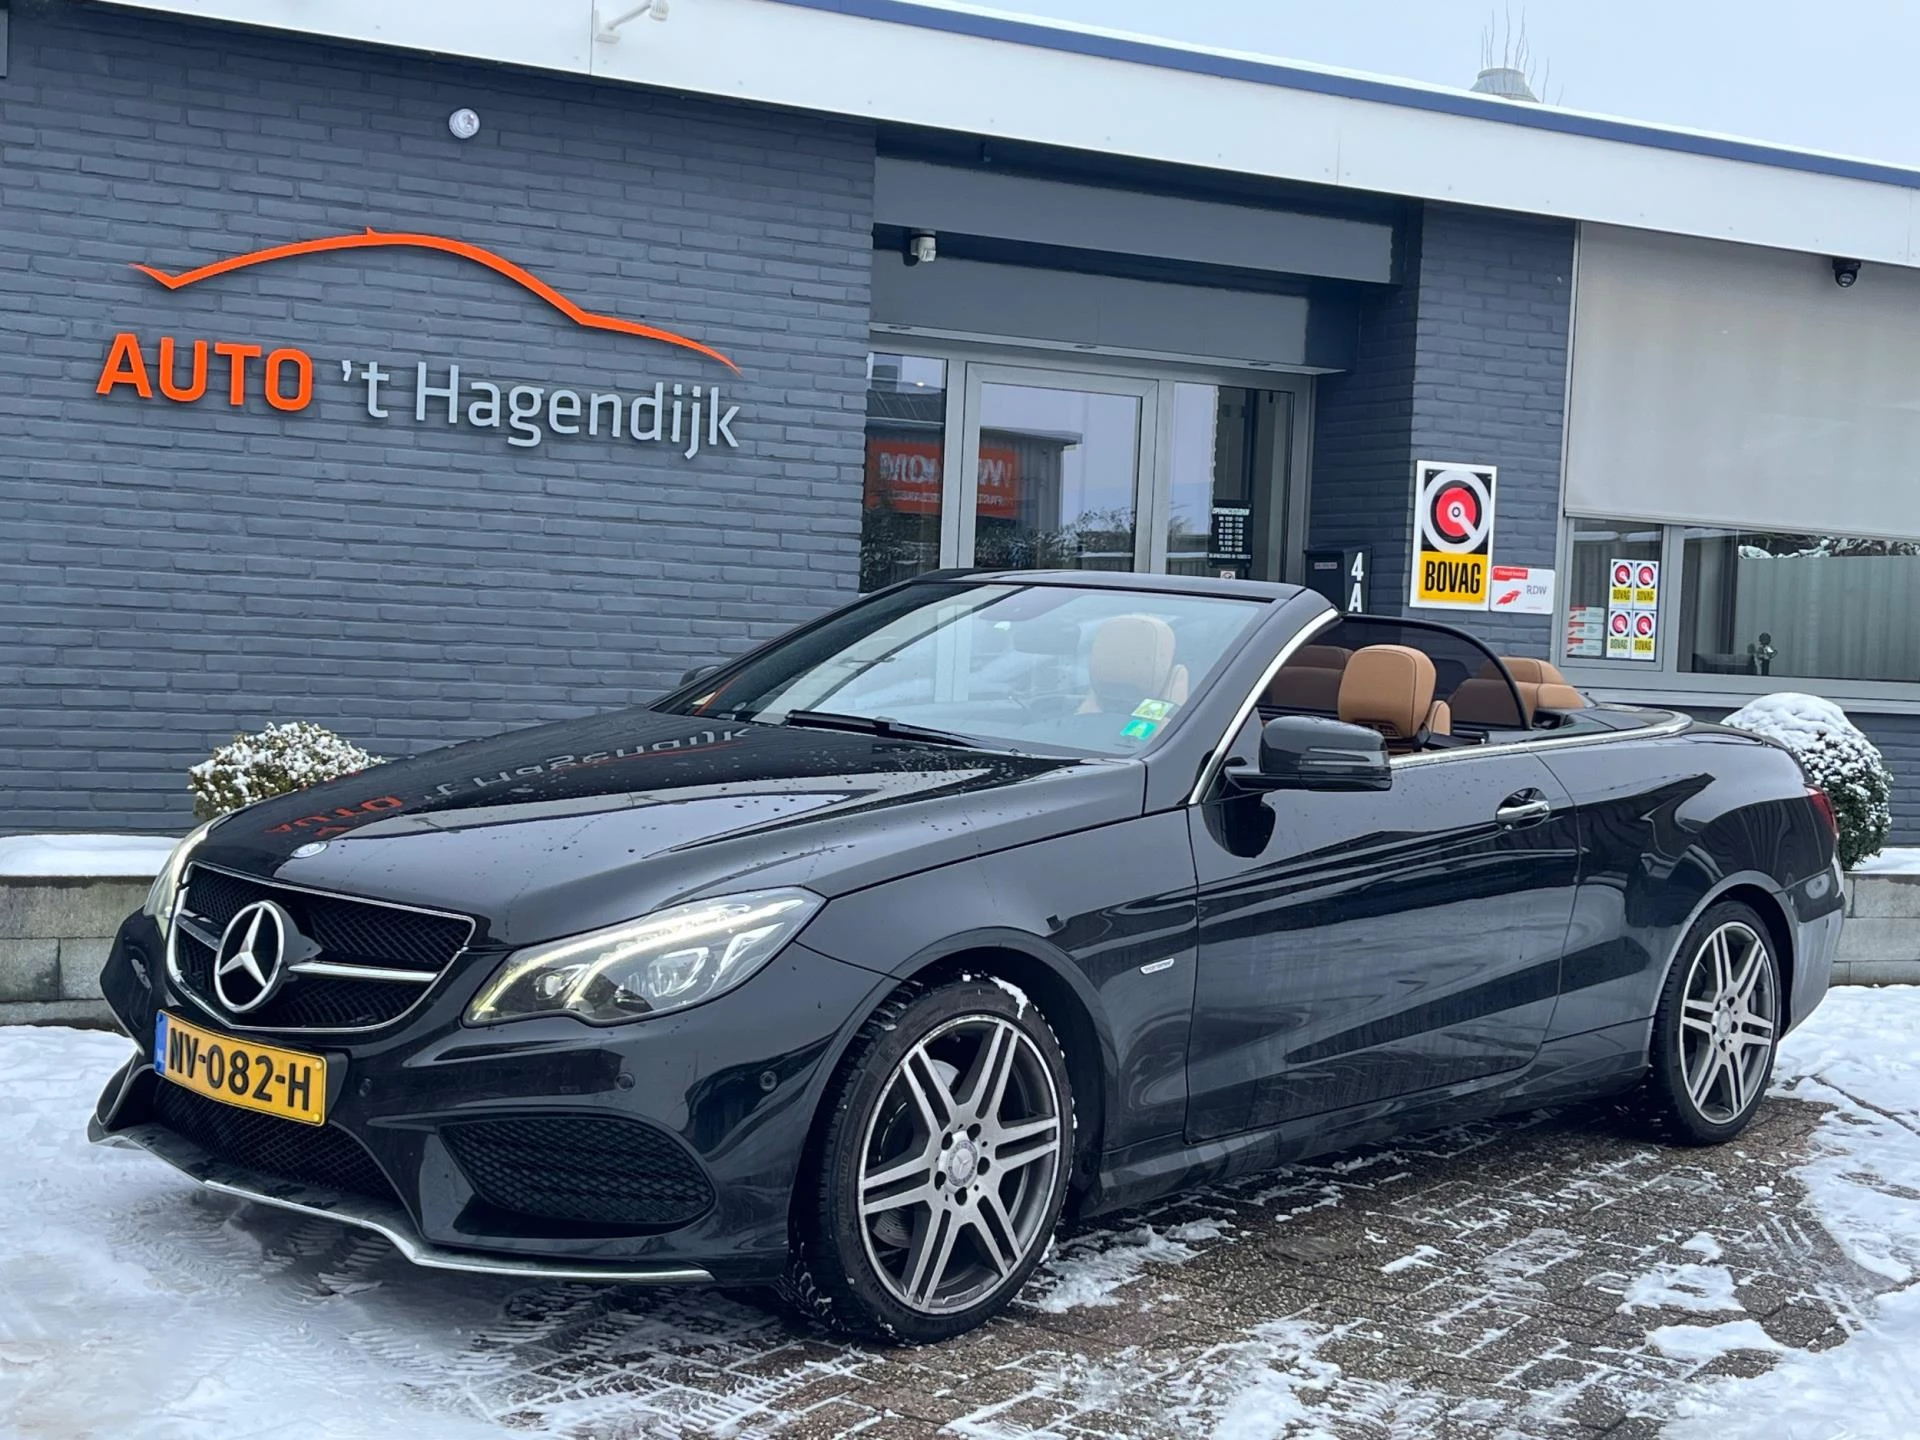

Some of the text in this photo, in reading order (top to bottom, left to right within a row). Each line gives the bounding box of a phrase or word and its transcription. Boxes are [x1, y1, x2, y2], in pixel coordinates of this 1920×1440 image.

[96, 333, 313, 411] AUTO
[415, 361, 741, 460] Hagendijk
[1348, 551, 1364, 613] 4 A
[1424, 560, 1481, 594] BOVAG
[1526, 585, 1547, 596] RDW
[169, 1026, 311, 1111] NV-082-H
